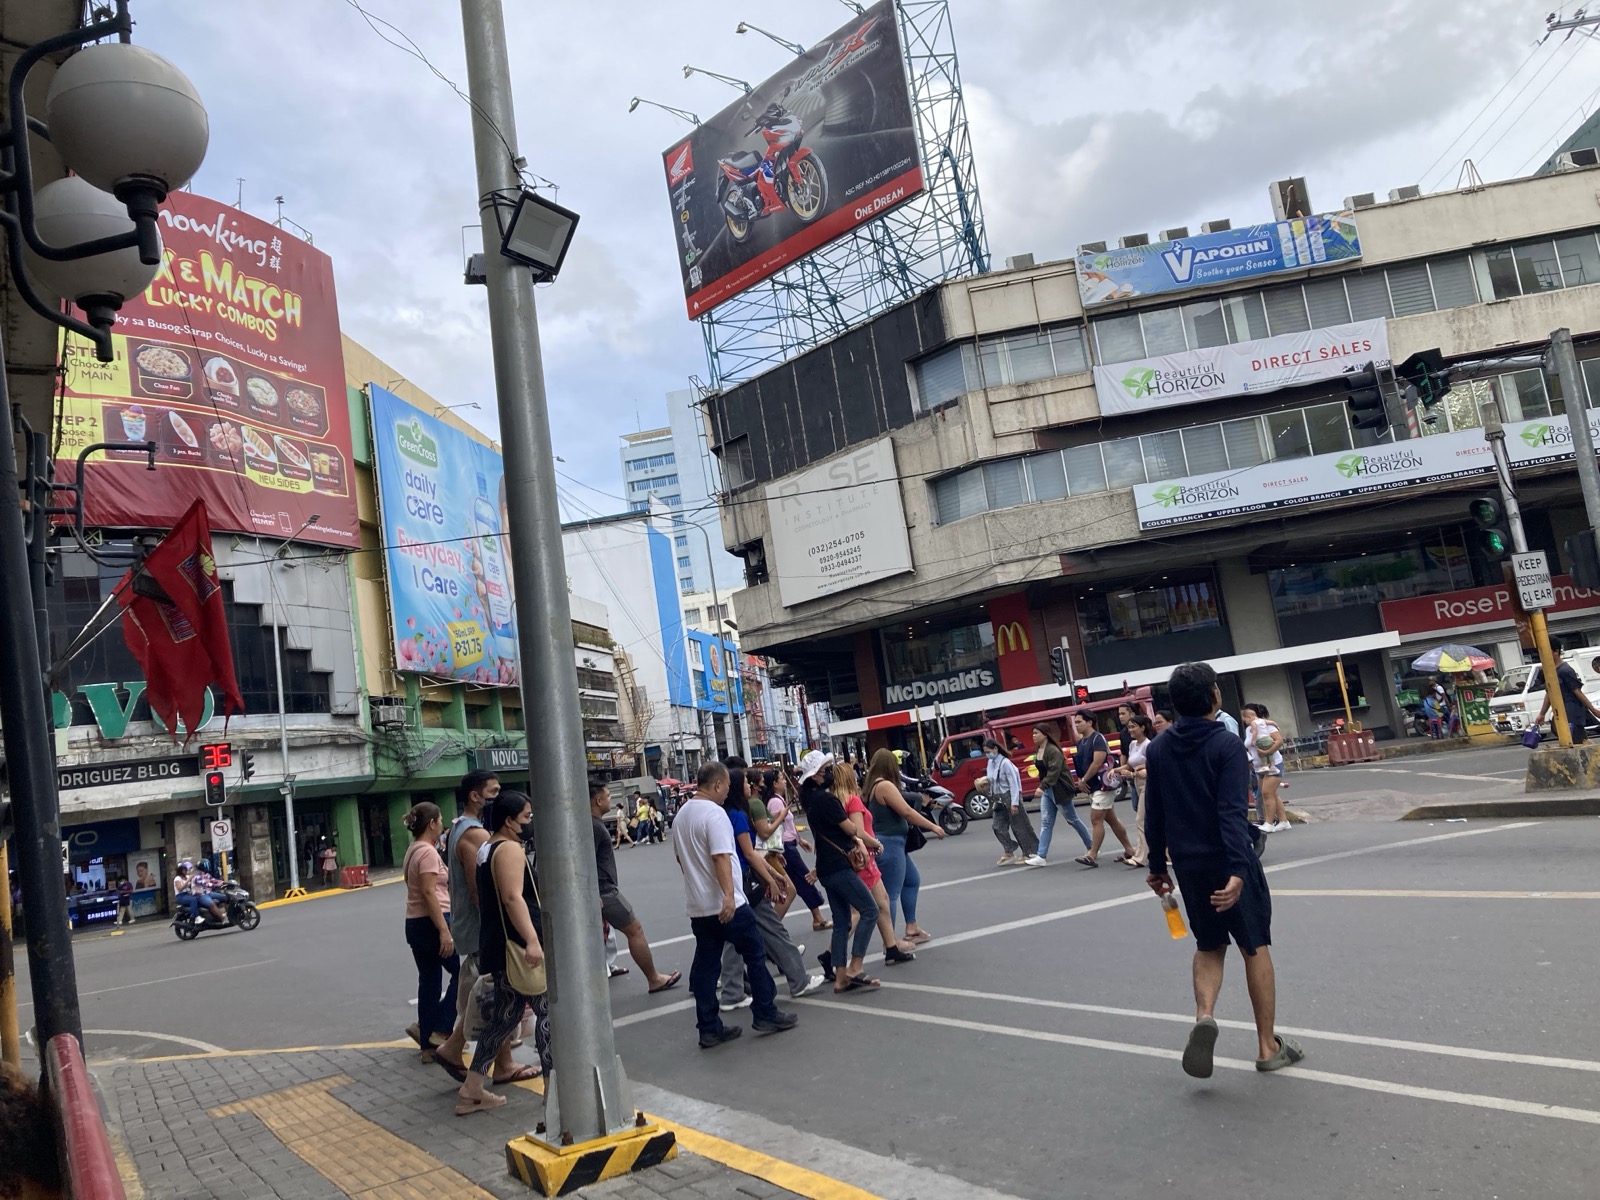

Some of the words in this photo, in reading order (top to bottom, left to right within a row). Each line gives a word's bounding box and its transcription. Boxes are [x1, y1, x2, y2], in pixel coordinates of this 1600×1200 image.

[809, 79, 823, 91] RIDE
[824, 69, 838, 80] LIKE
[846, 39, 881, 66] CHAMPION
[671, 166, 691, 183] HONDA
[845, 187, 855, 196] ASC
[855, 181, 865, 191] REF
[854, 204, 873, 220] ONE
[874, 187, 904, 211] DREAM
[1105, 256, 1145, 269] HORIZON
[1163, 240, 1269, 281] VAPORIN
[1196, 266, 1224, 279] Soothe
[1225, 265, 1244, 277] your
[1245, 257, 1278, 271] Senses
[200, 252, 301, 327] MATCH
[145, 283, 213, 313] LUCKY
[217, 301, 277, 341] COMBOS
[132, 318, 145, 327] sa
[147, 318, 212, 340] Busog-Sarap
[215, 331, 246, 353] Choices,
[246, 344, 268, 361] Lucky
[269, 357, 279, 366] sa
[278, 355, 307, 373] Savings!
[70, 358, 110, 370] Choose
[1251, 349, 1310, 372] DIRECT
[1319, 340, 1372, 359] SALES
[81, 369, 113, 381] MAIN
[1154, 362, 1215, 380] Beautiful
[1146, 372, 1225, 396] HORIZON
[89, 417, 98, 427] 2
[60, 438, 85, 447] SIDE
[399, 435, 436, 462] GreenCross
[1455, 448, 1478, 456] DIRECT
[1356, 457, 1423, 475] HORIZON
[1363, 449, 1414, 464] Beautiful
[259, 474, 275, 484] NEW
[277, 478, 300, 489] SIDES
[405, 469, 436, 500] daily
[1173, 513, 1204, 523] BRANCH
[1217, 508, 1241, 517] UPPER
[1242, 503, 1267, 512] FLOOR
[1284, 497, 1307, 505] COLON
[1308, 491, 1341, 501] BRANCH
[1383, 480, 1409, 489] FLOOR
[1426, 474, 1453, 482] COLON
[1453, 468, 1486, 478] BRANCH
[1531, 456, 1556, 464] FLOOR
[1180, 481, 1230, 494] Beautiful
[1263, 479, 1287, 488] DIRECT
[1288, 476, 1309, 485] SALES
[785, 486, 879, 526] INSTITUTE
[1173, 487, 1239, 506] HORIZON
[406, 494, 444, 525] care
[794, 514, 833, 533] COSMETOLOGY
[841, 501, 871, 517] PHARMACY
[397, 528, 465, 574] Everyday,
[808, 530, 865, 557] (032)254-0705
[820, 554, 862, 573] 0933-0494337
[1517, 558, 1541, 570] KEEP
[412, 565, 419, 589] I
[421, 567, 458, 597] Care
[1516, 573, 1550, 587] PEDESTRIAN
[1522, 588, 1552, 602] CLEAR
[1434, 597, 1493, 619] Rose
[886, 668, 994, 704] McDonald's
[1077, 688, 1087, 697] 36
[204, 744, 230, 768] 36
[491, 750, 518, 766] NOVO
[58, 767, 132, 787] DRIGUEZ
[137, 762, 180, 779] BLDG
[87, 909, 117, 920] SAMSUNG
